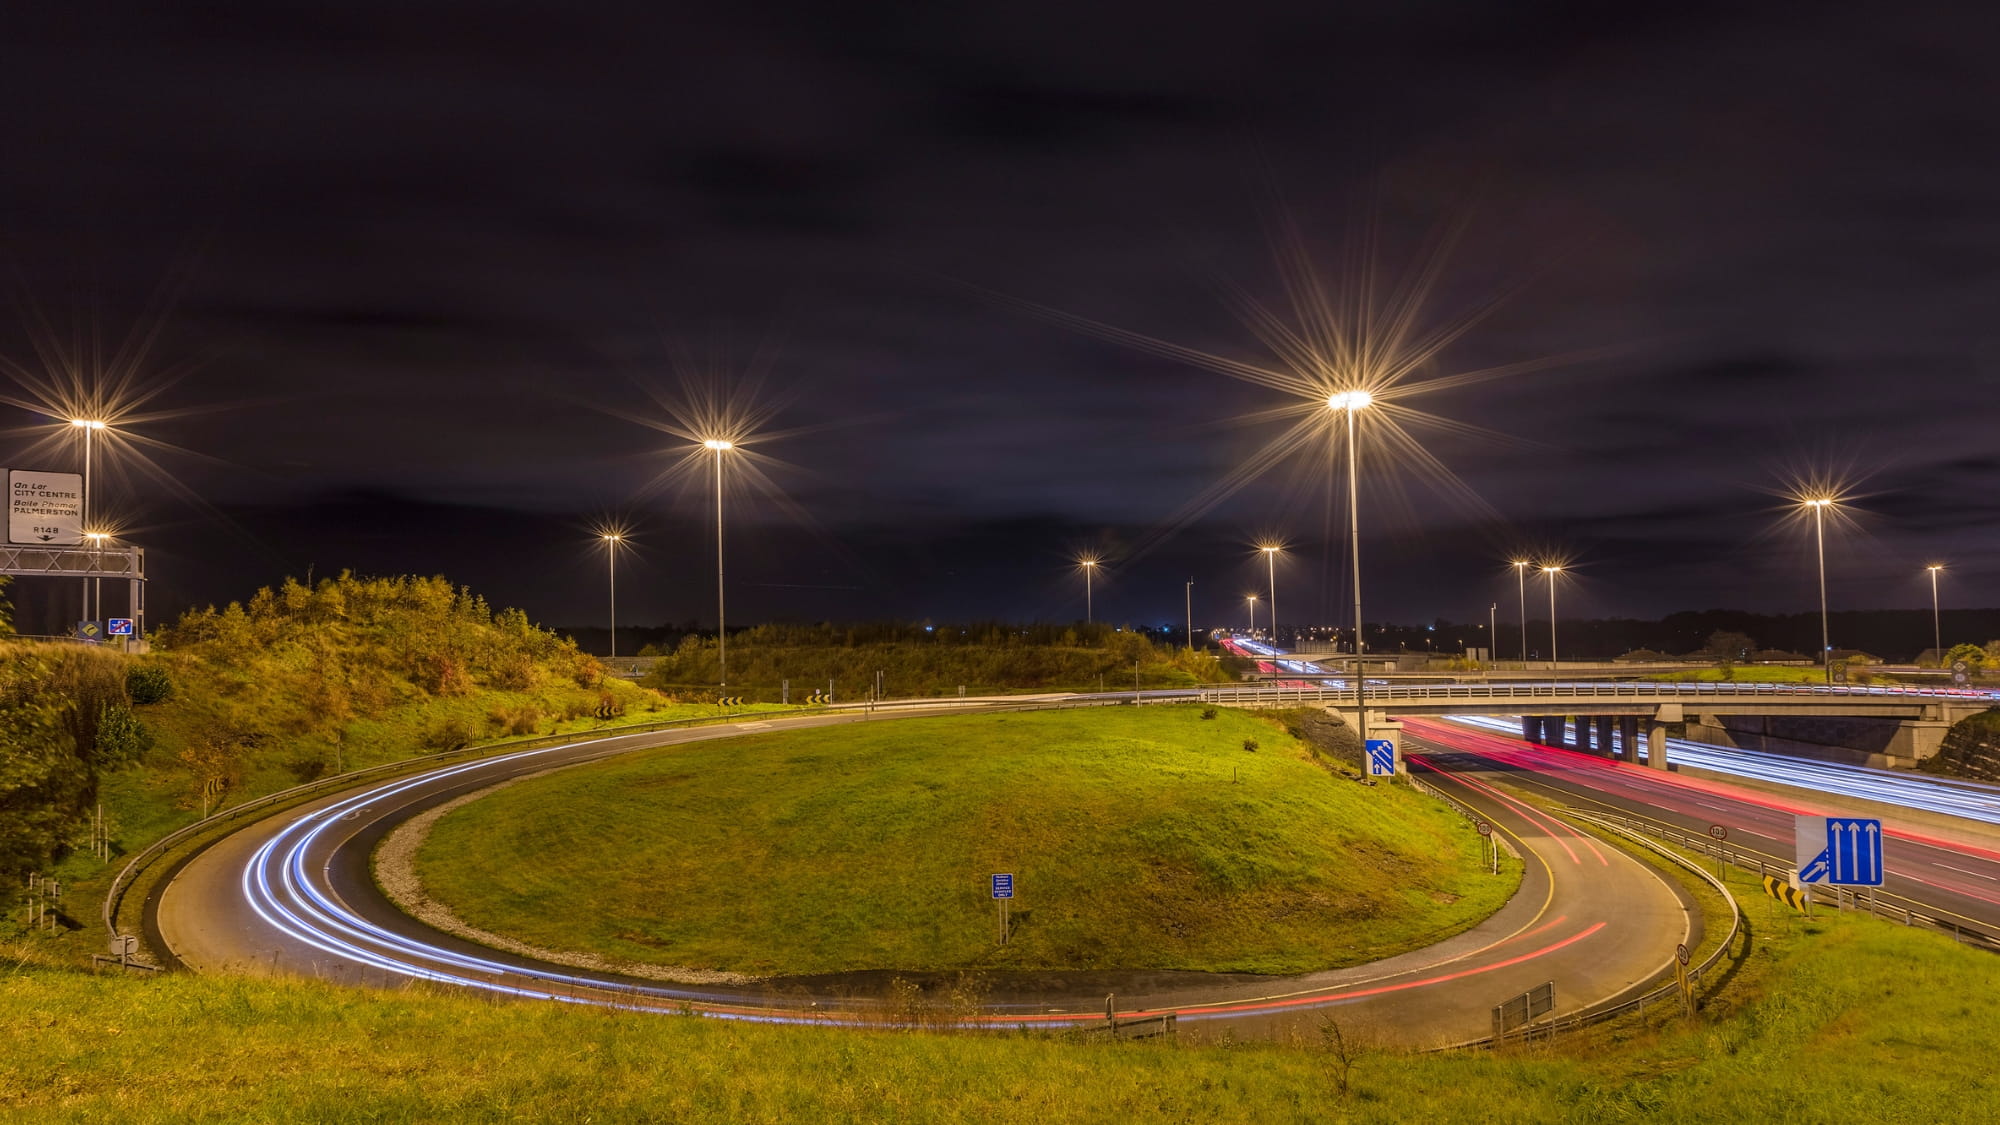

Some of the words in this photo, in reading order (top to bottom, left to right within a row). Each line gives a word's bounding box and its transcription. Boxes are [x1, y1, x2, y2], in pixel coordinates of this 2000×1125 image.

[39, 491, 77, 499] CENTRE
[14, 507, 78, 516] PALMERSTON
[33, 526, 59, 534] R148
[1712, 828, 1725, 836] 100
